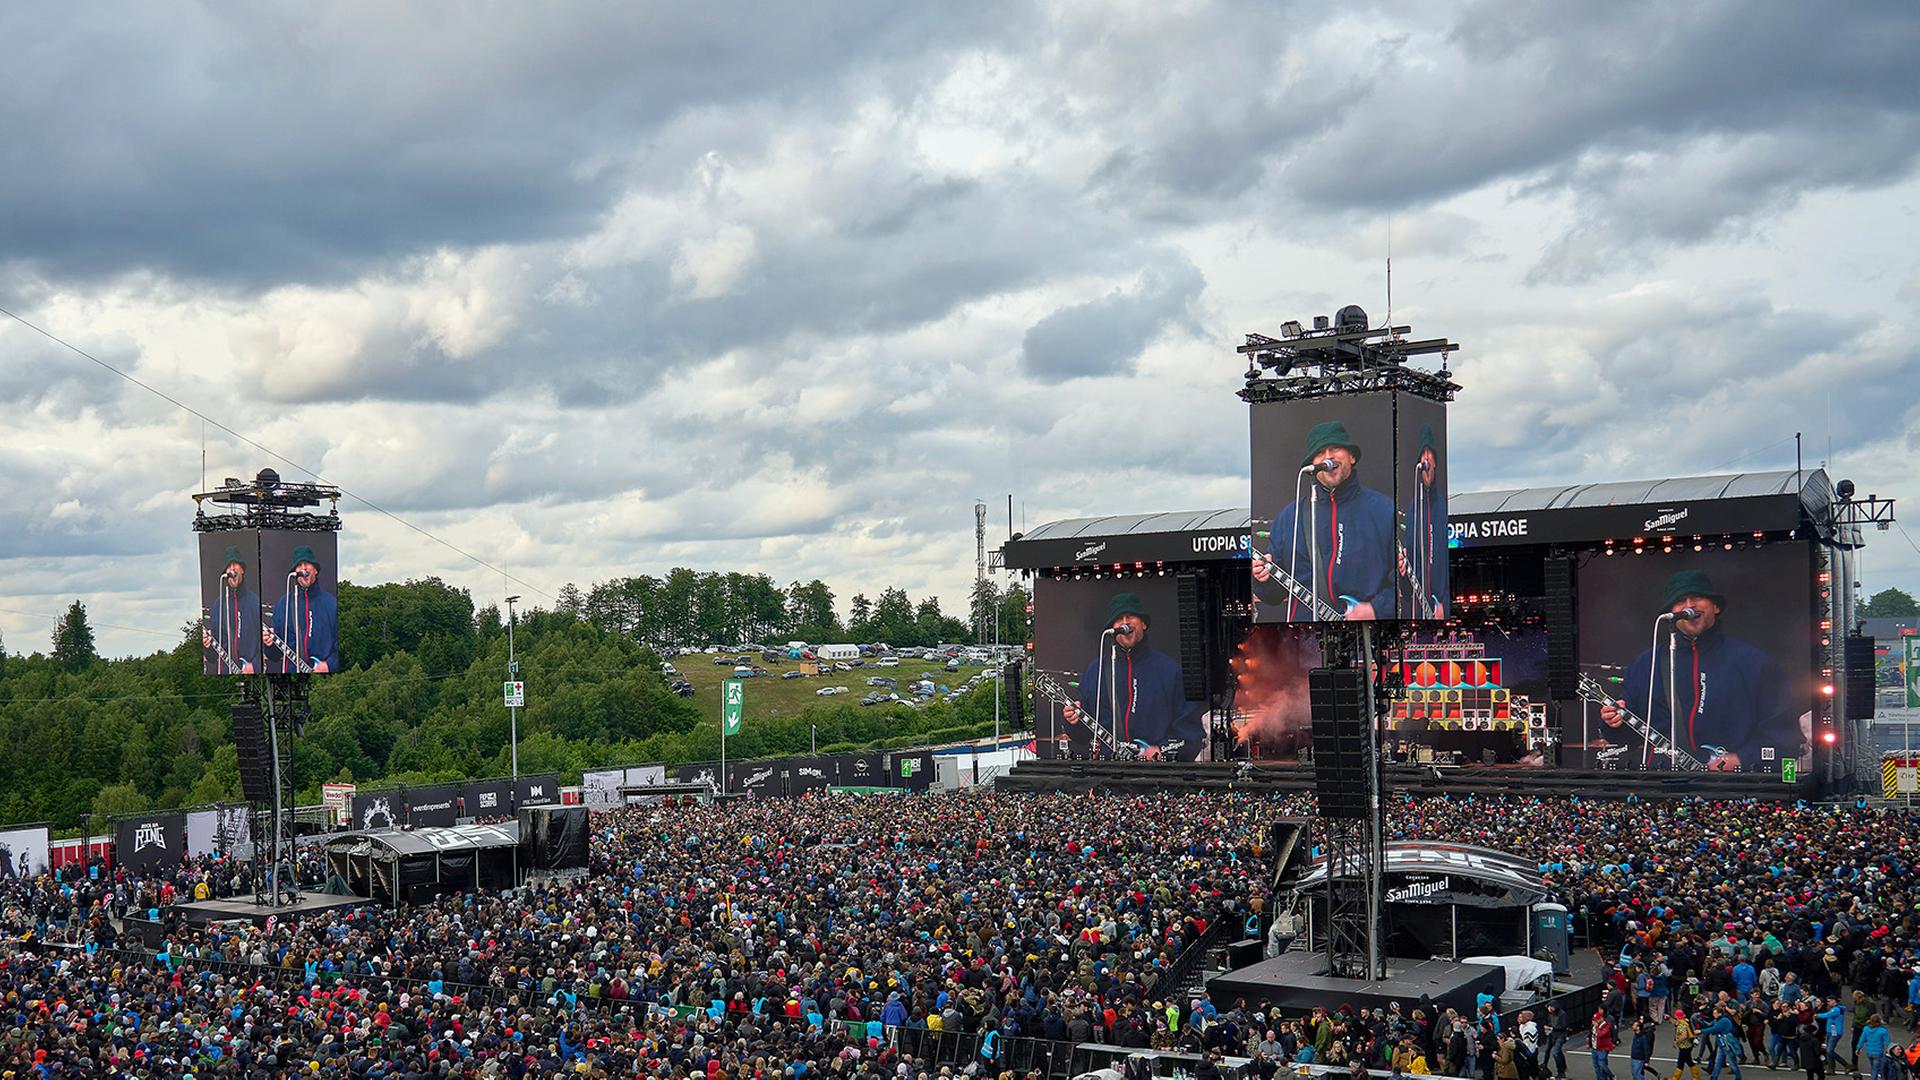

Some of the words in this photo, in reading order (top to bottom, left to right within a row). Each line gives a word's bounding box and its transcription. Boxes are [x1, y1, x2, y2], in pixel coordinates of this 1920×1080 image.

[1481, 518, 1528, 537] STAGE
[1192, 535, 1237, 553] UTOPIA
[134, 826, 167, 853] RING
